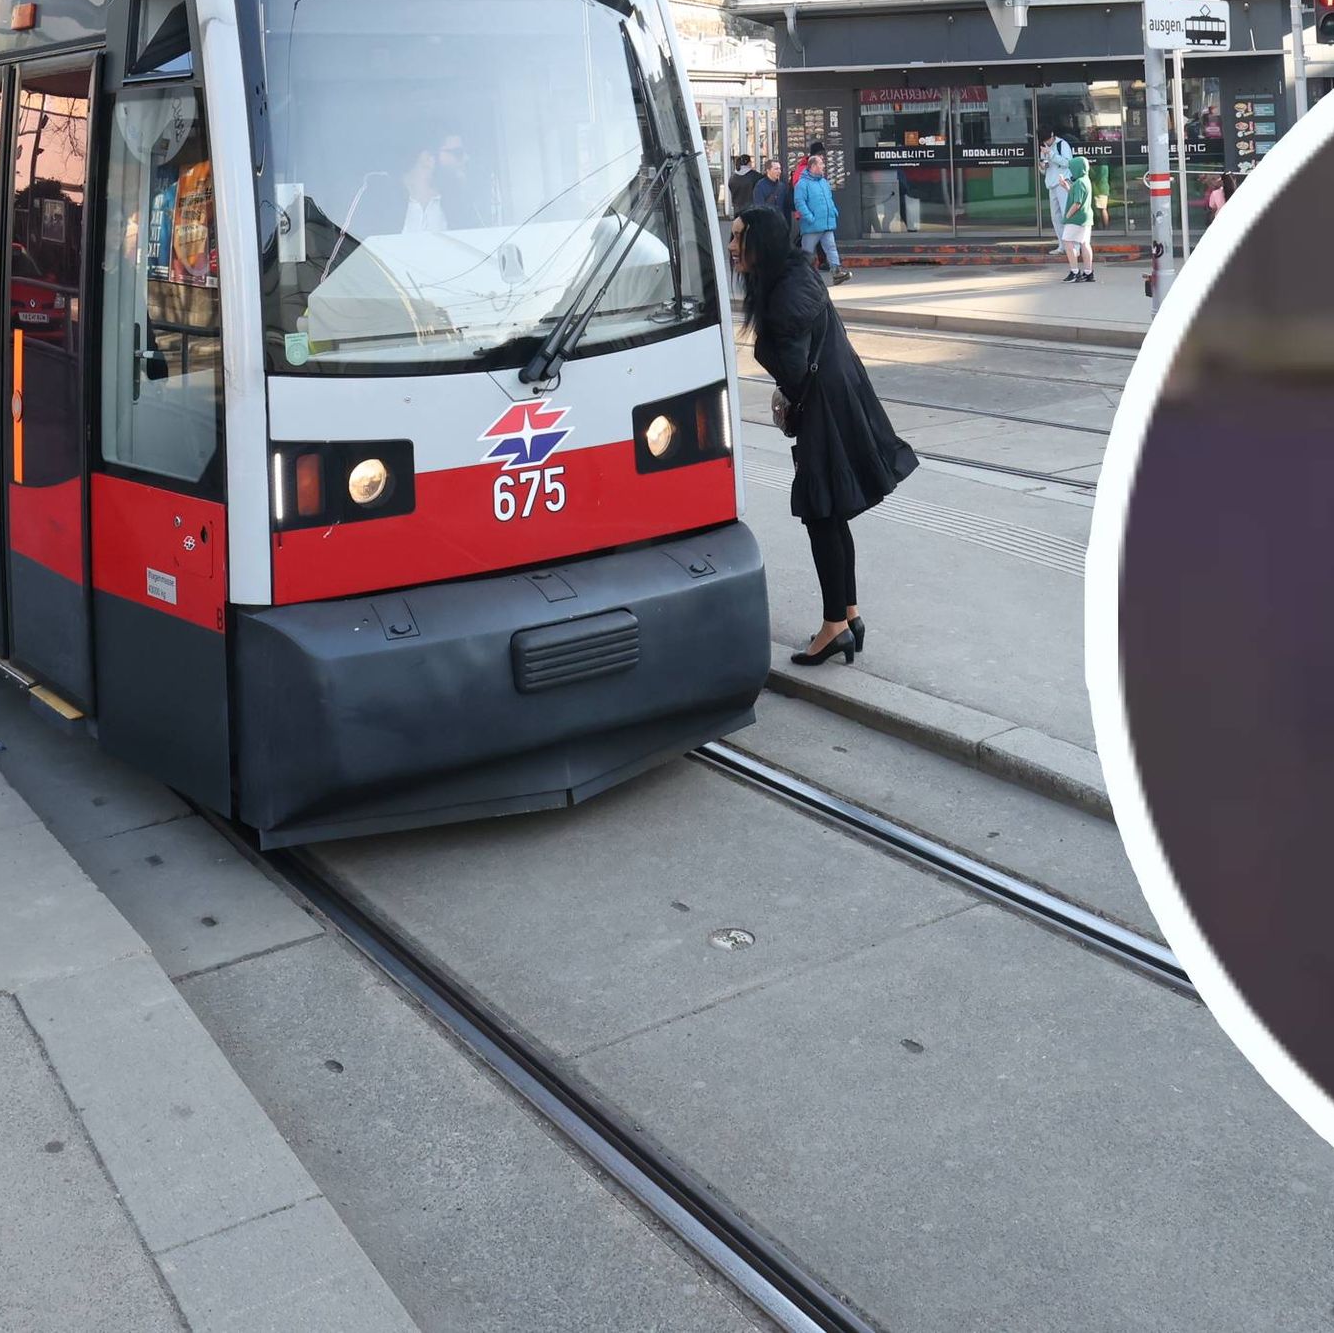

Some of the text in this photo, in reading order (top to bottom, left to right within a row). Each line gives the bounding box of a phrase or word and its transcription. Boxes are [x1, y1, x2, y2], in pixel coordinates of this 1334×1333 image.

[1149, 18, 1184, 35] ausgen.
[1072, 146, 1112, 155] LEKING
[492, 465, 567, 523] 675
